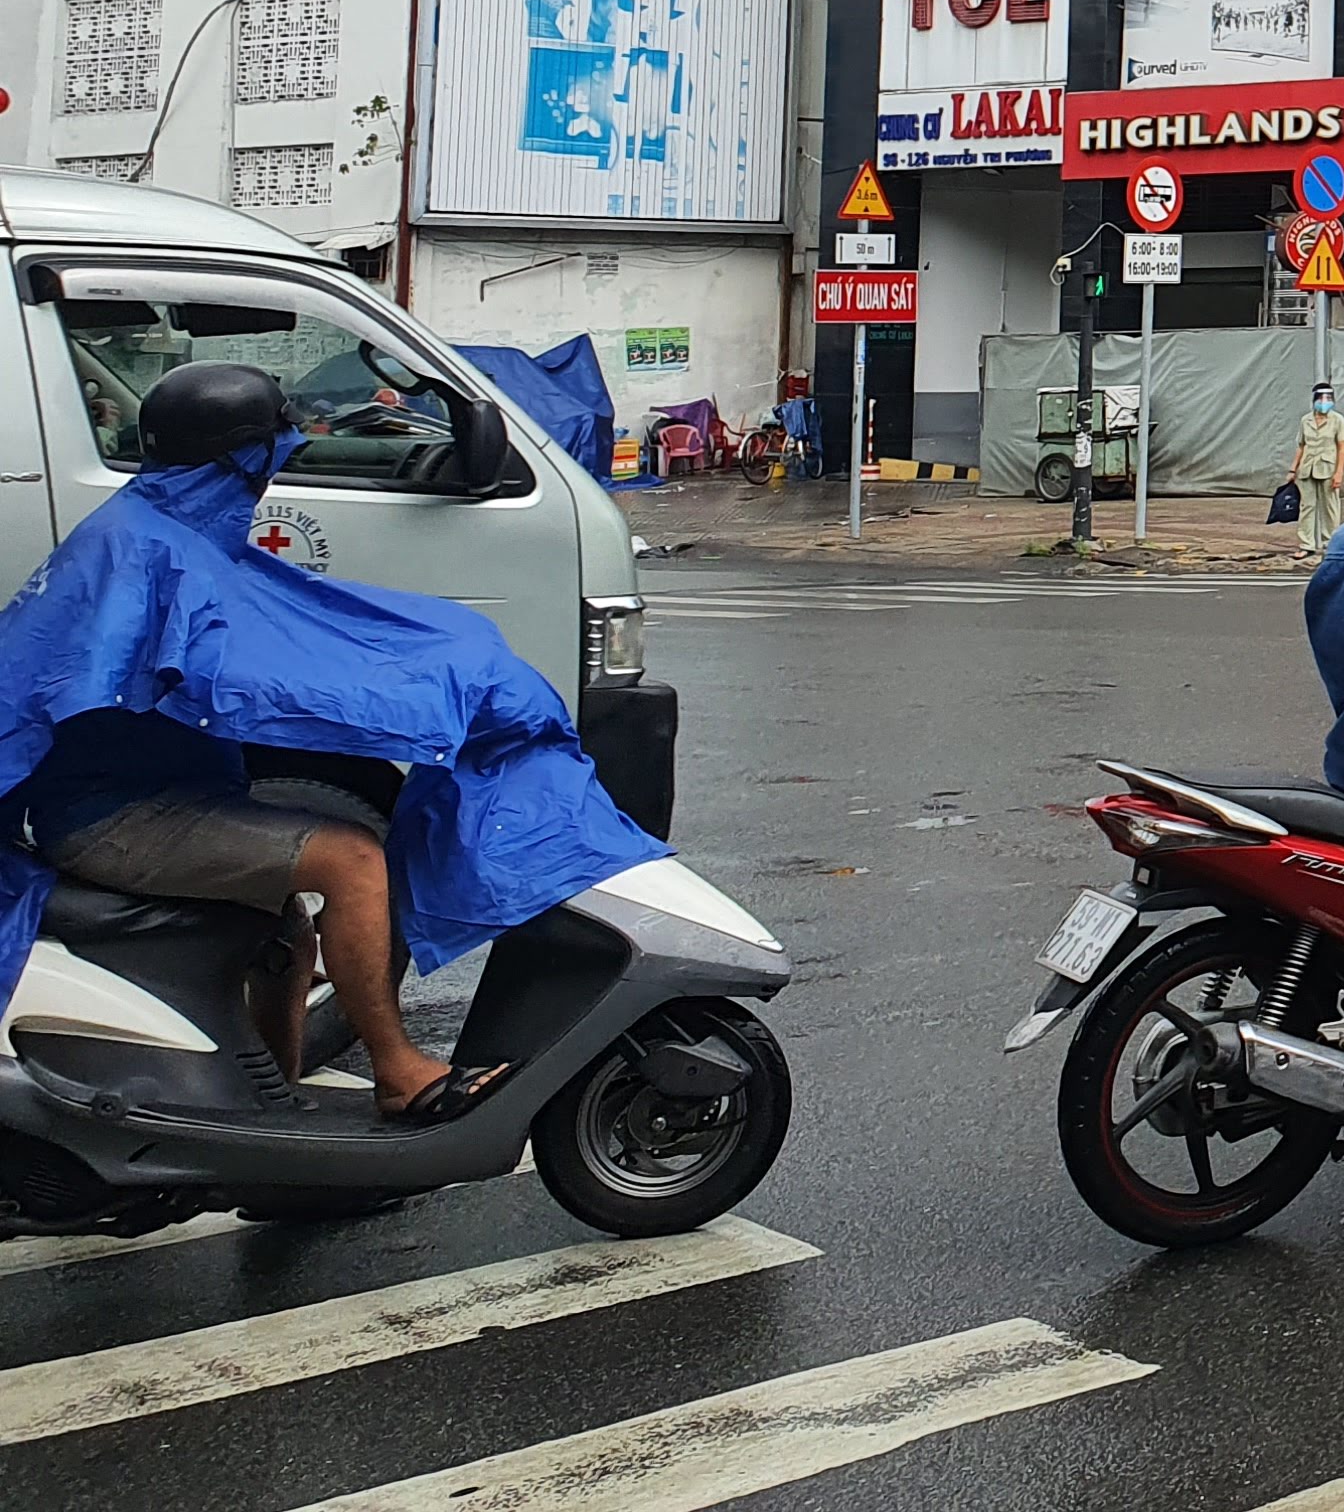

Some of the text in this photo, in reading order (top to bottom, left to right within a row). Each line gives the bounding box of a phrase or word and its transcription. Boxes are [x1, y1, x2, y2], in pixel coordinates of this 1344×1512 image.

[878, 113, 920, 142] CHUNG
[949, 88, 1063, 140] LAKAI
[818, 276, 915, 311] CHÚ Ý QUAN SÁT
[266, 505, 295, 519] 115
